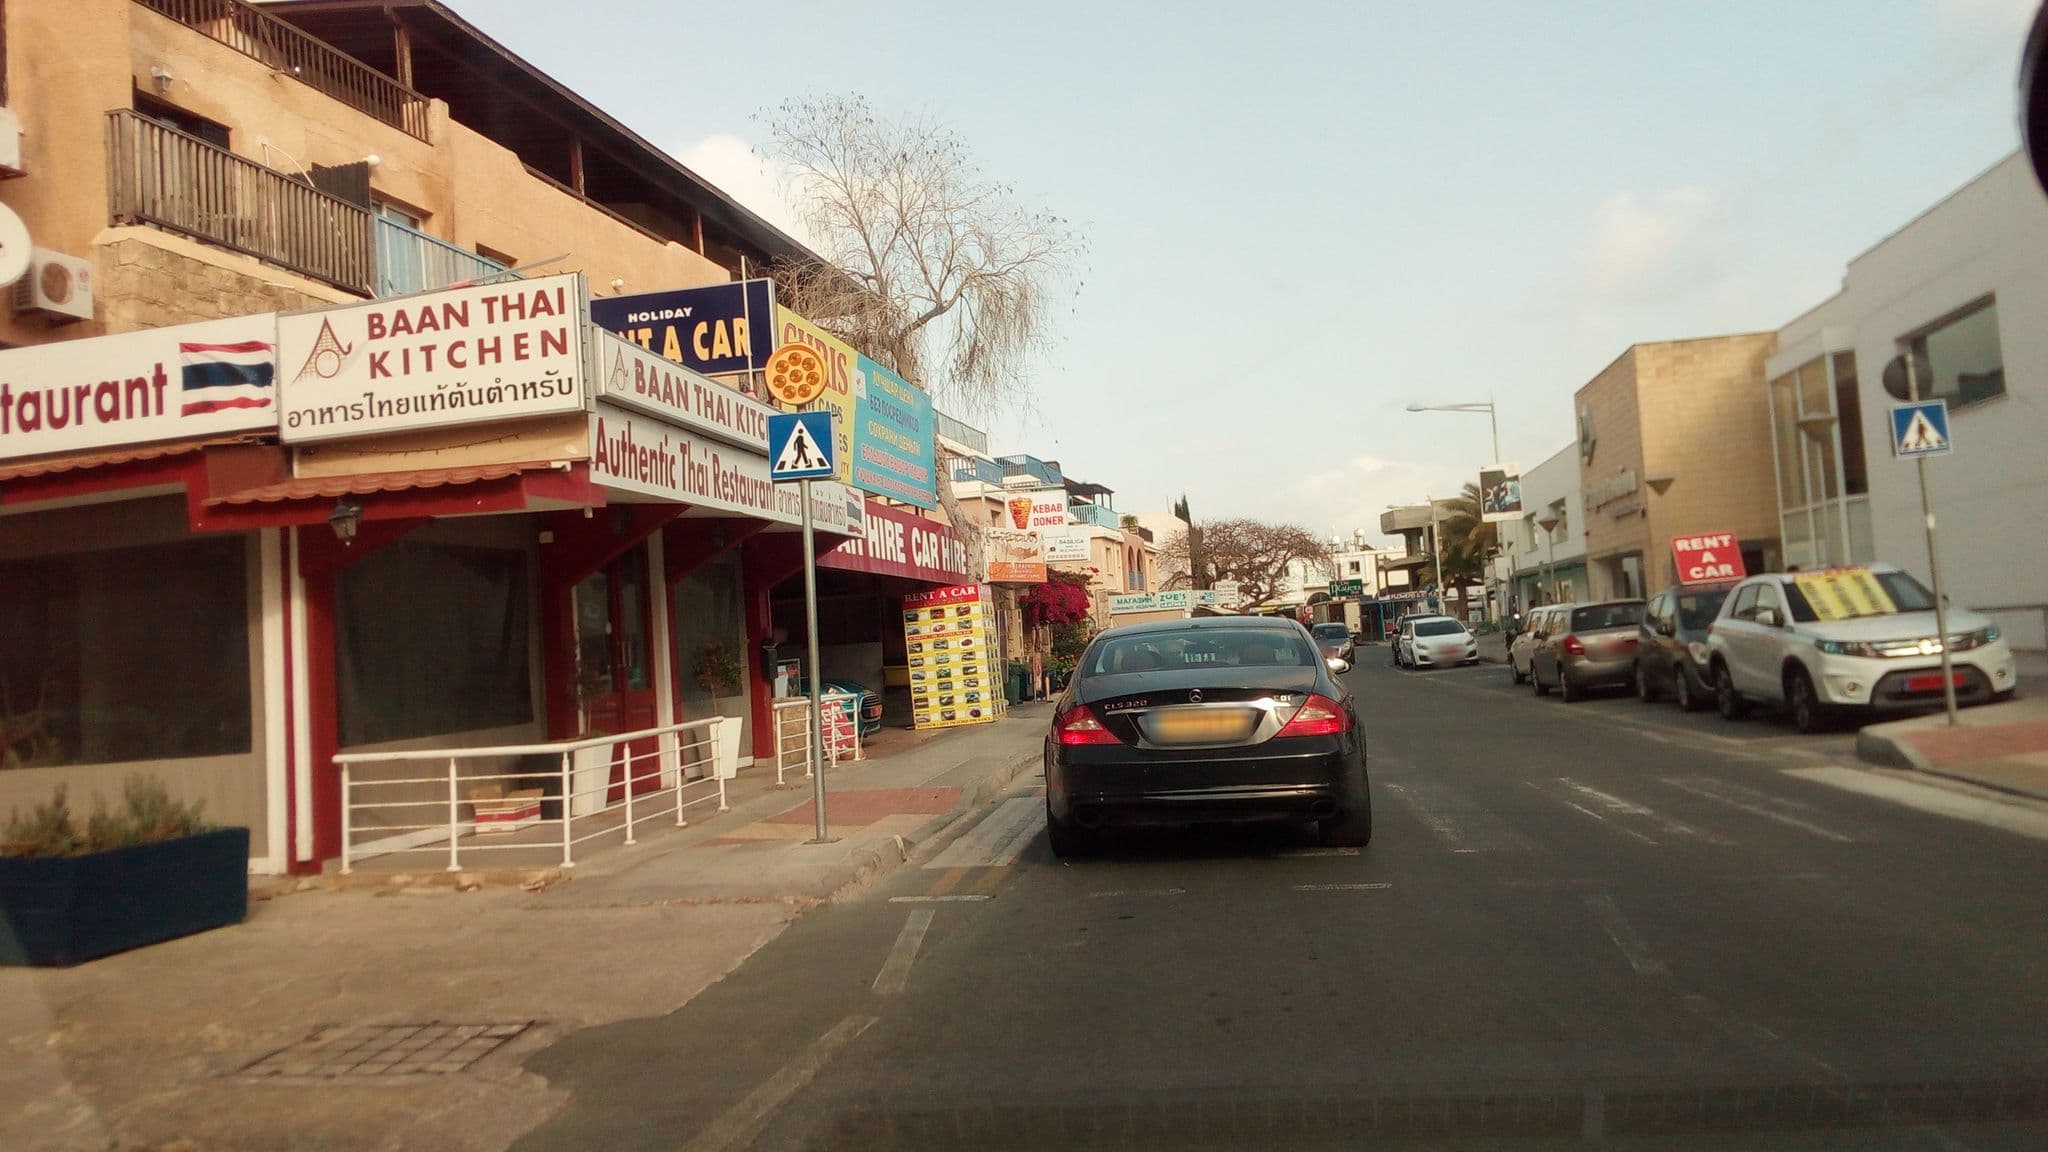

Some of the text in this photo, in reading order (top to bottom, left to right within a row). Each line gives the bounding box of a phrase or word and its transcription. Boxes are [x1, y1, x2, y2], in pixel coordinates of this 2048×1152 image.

[367, 286, 566, 341] BAAN THAI
[628, 306, 693, 323] HOLIDAY
[662, 325, 683, 363] A
[693, 317, 752, 361] CAR
[368, 327, 569, 380] KITCHEN
[634, 357, 690, 412] BAAN
[694, 383, 732, 428] THAI
[594, 416, 776, 512] Authentic Thai Restaurant
[1032, 503, 1063, 513] KEBAB
[1033, 515, 1064, 527] DONER
[866, 514, 906, 564] HIRE
[911, 526, 940, 570] CAR
[941, 535, 968, 575] HIRE
[1675, 534, 1732, 552] RENT
[1701, 551, 1717, 564] A
[1689, 563, 1734, 579] CAR
[904, 591, 935, 602] RENT
[939, 588, 947, 598] A
[951, 585, 977, 596] CAR
[1116, 596, 1153, 606] МАГАЗИН
